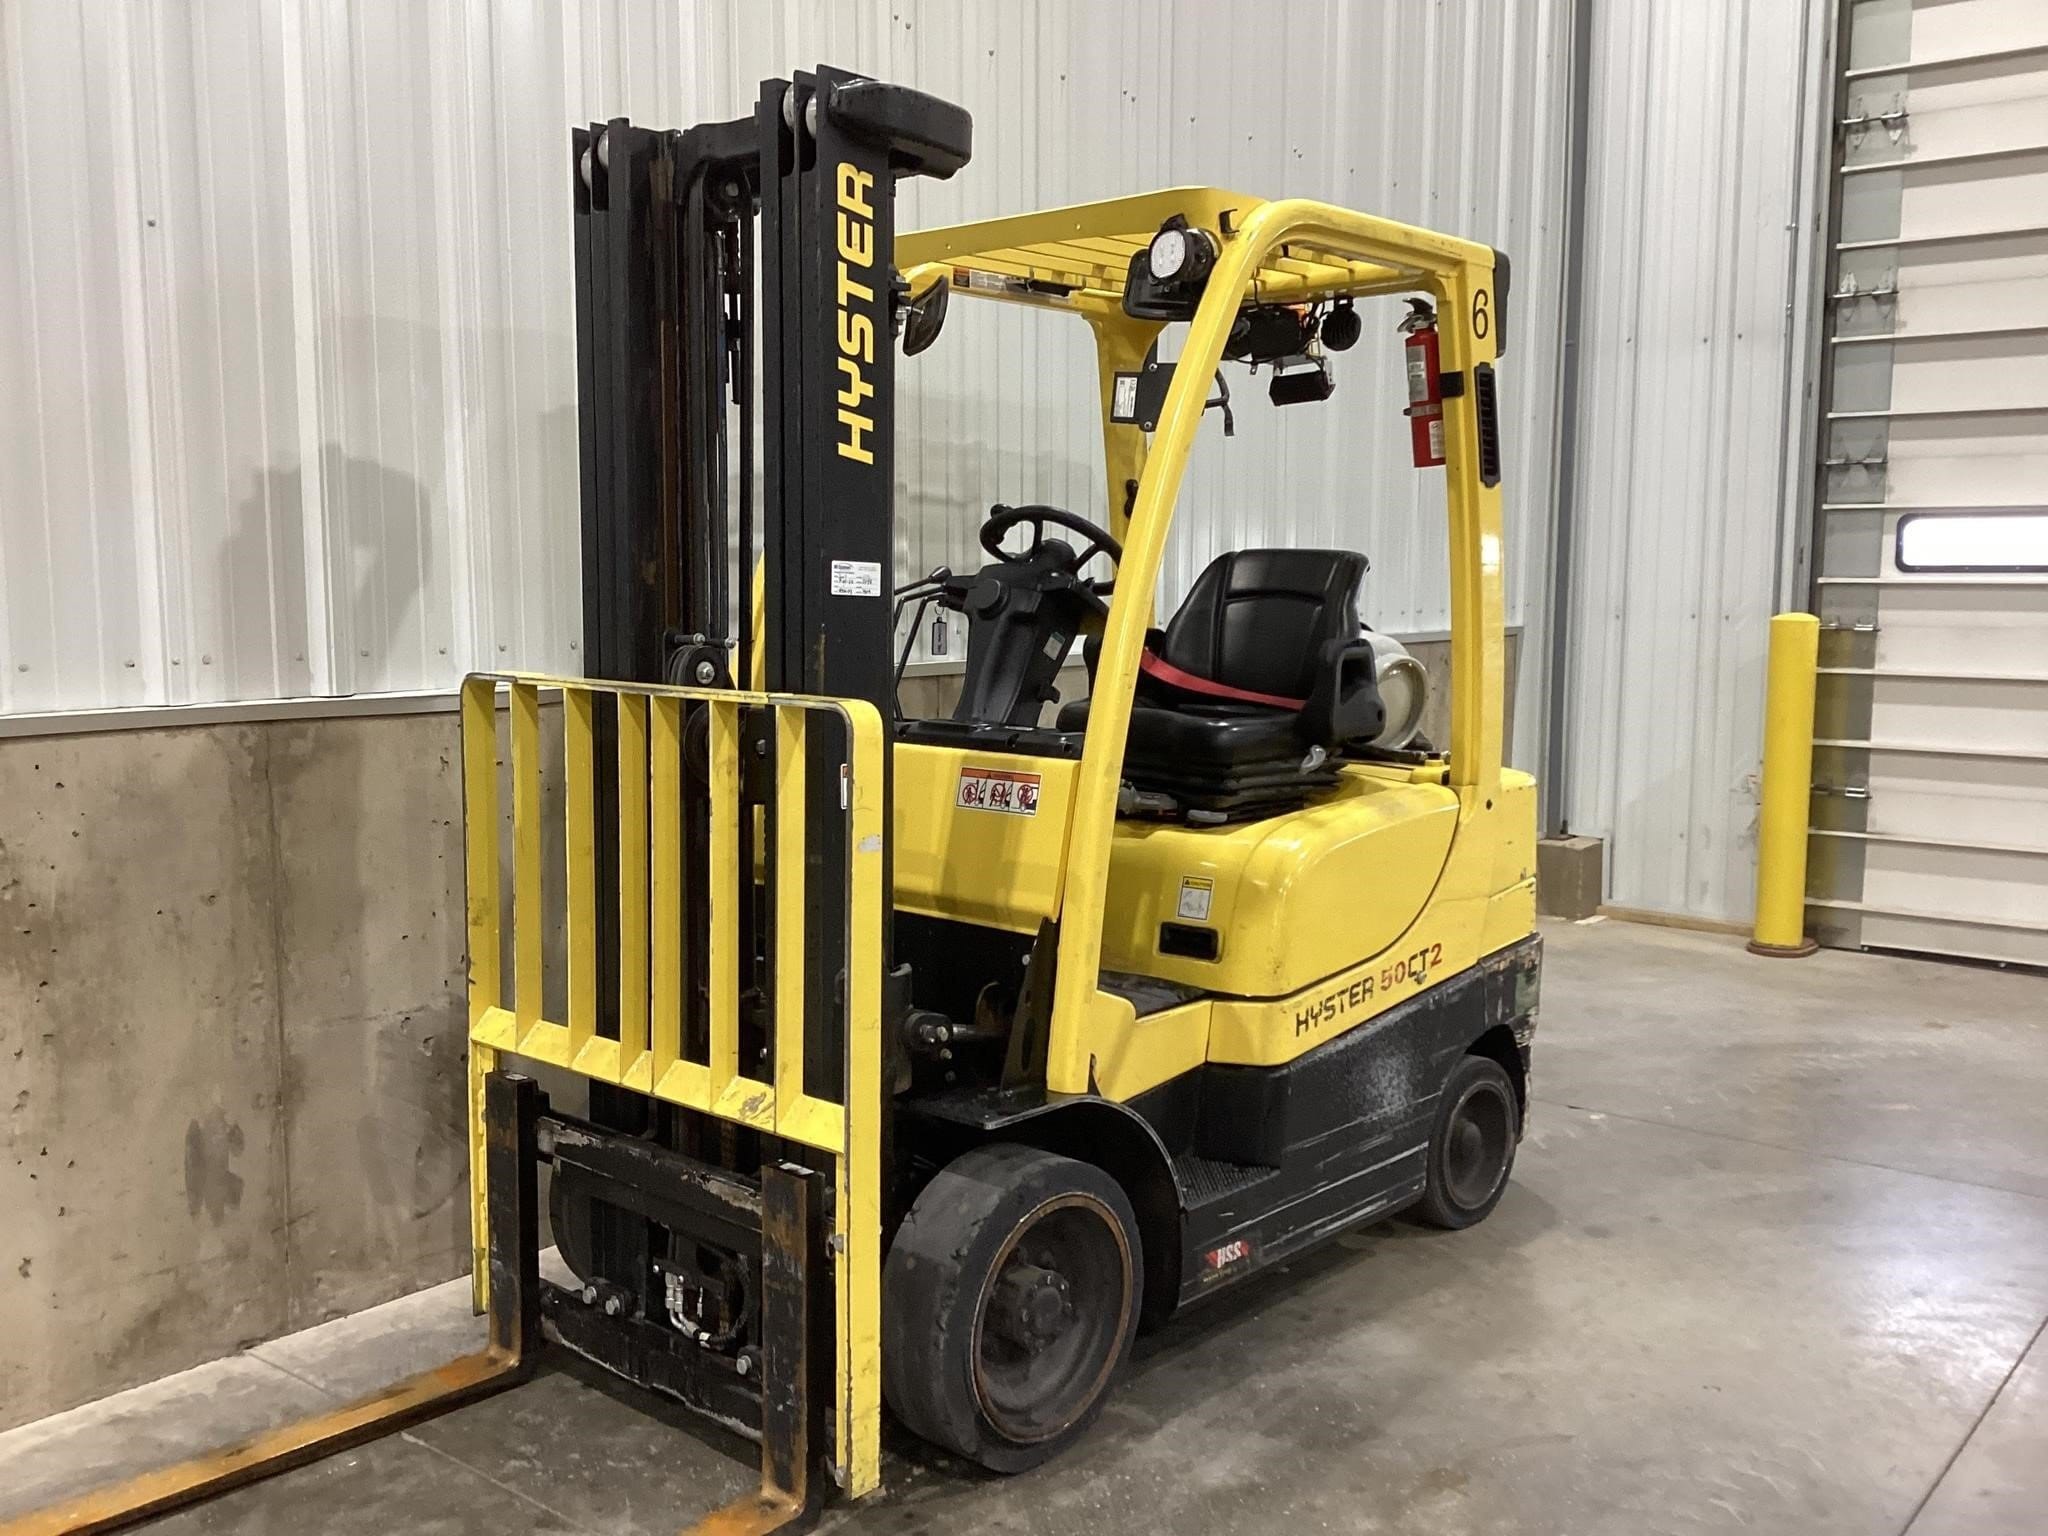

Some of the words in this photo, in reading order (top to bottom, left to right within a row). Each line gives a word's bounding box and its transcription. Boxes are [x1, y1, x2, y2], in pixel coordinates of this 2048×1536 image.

[836, 162, 875, 465] HYSTER
[1472, 288, 1489, 340] 6
[1295, 975, 1374, 1037] HYSTER
[1380, 942, 1443, 992] 50CT2
